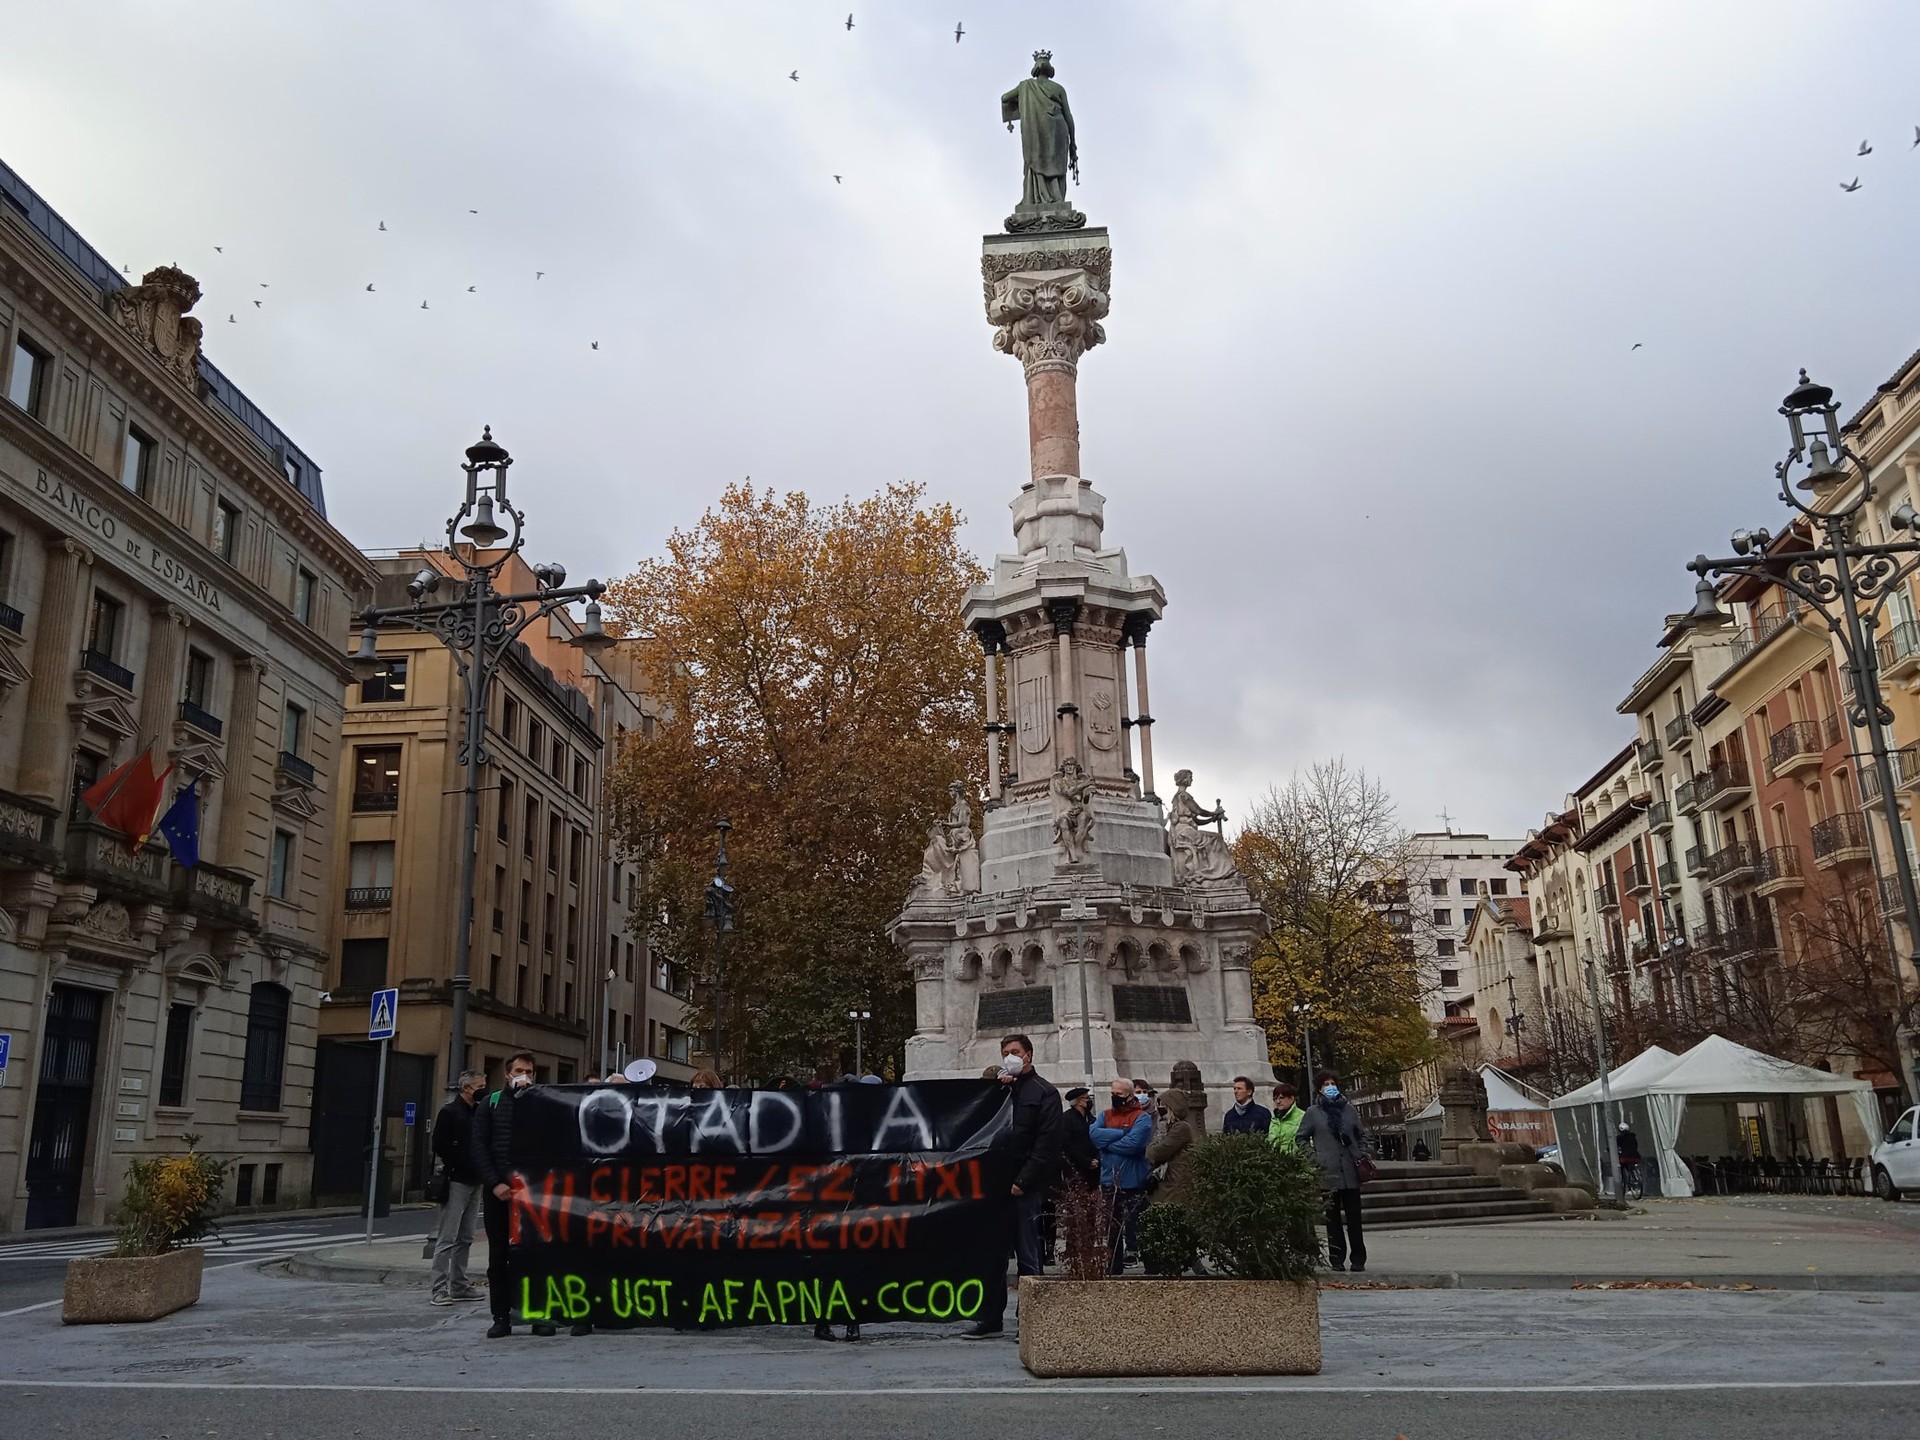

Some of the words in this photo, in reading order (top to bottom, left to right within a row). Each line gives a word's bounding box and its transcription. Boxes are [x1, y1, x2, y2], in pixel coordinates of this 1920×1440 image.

[35, 468, 116, 540] BANCO
[126, 538, 141, 560] DE
[151, 548, 221, 612] ESPAÑA
[578, 1086, 934, 1154] OTADIA
[1488, 1116, 1540, 1138] SARASATE
[508, 1170, 575, 1246] NI
[590, 1165, 736, 1204] CIERRE
[787, 1164, 855, 1201] EZ
[889, 1160, 985, 1201] ITXI
[521, 1275, 590, 1320] LAB
[612, 1278, 672, 1318] UGT
[698, 1280, 856, 1323] AFAPNA
[878, 1279, 984, 1318] CCOO
